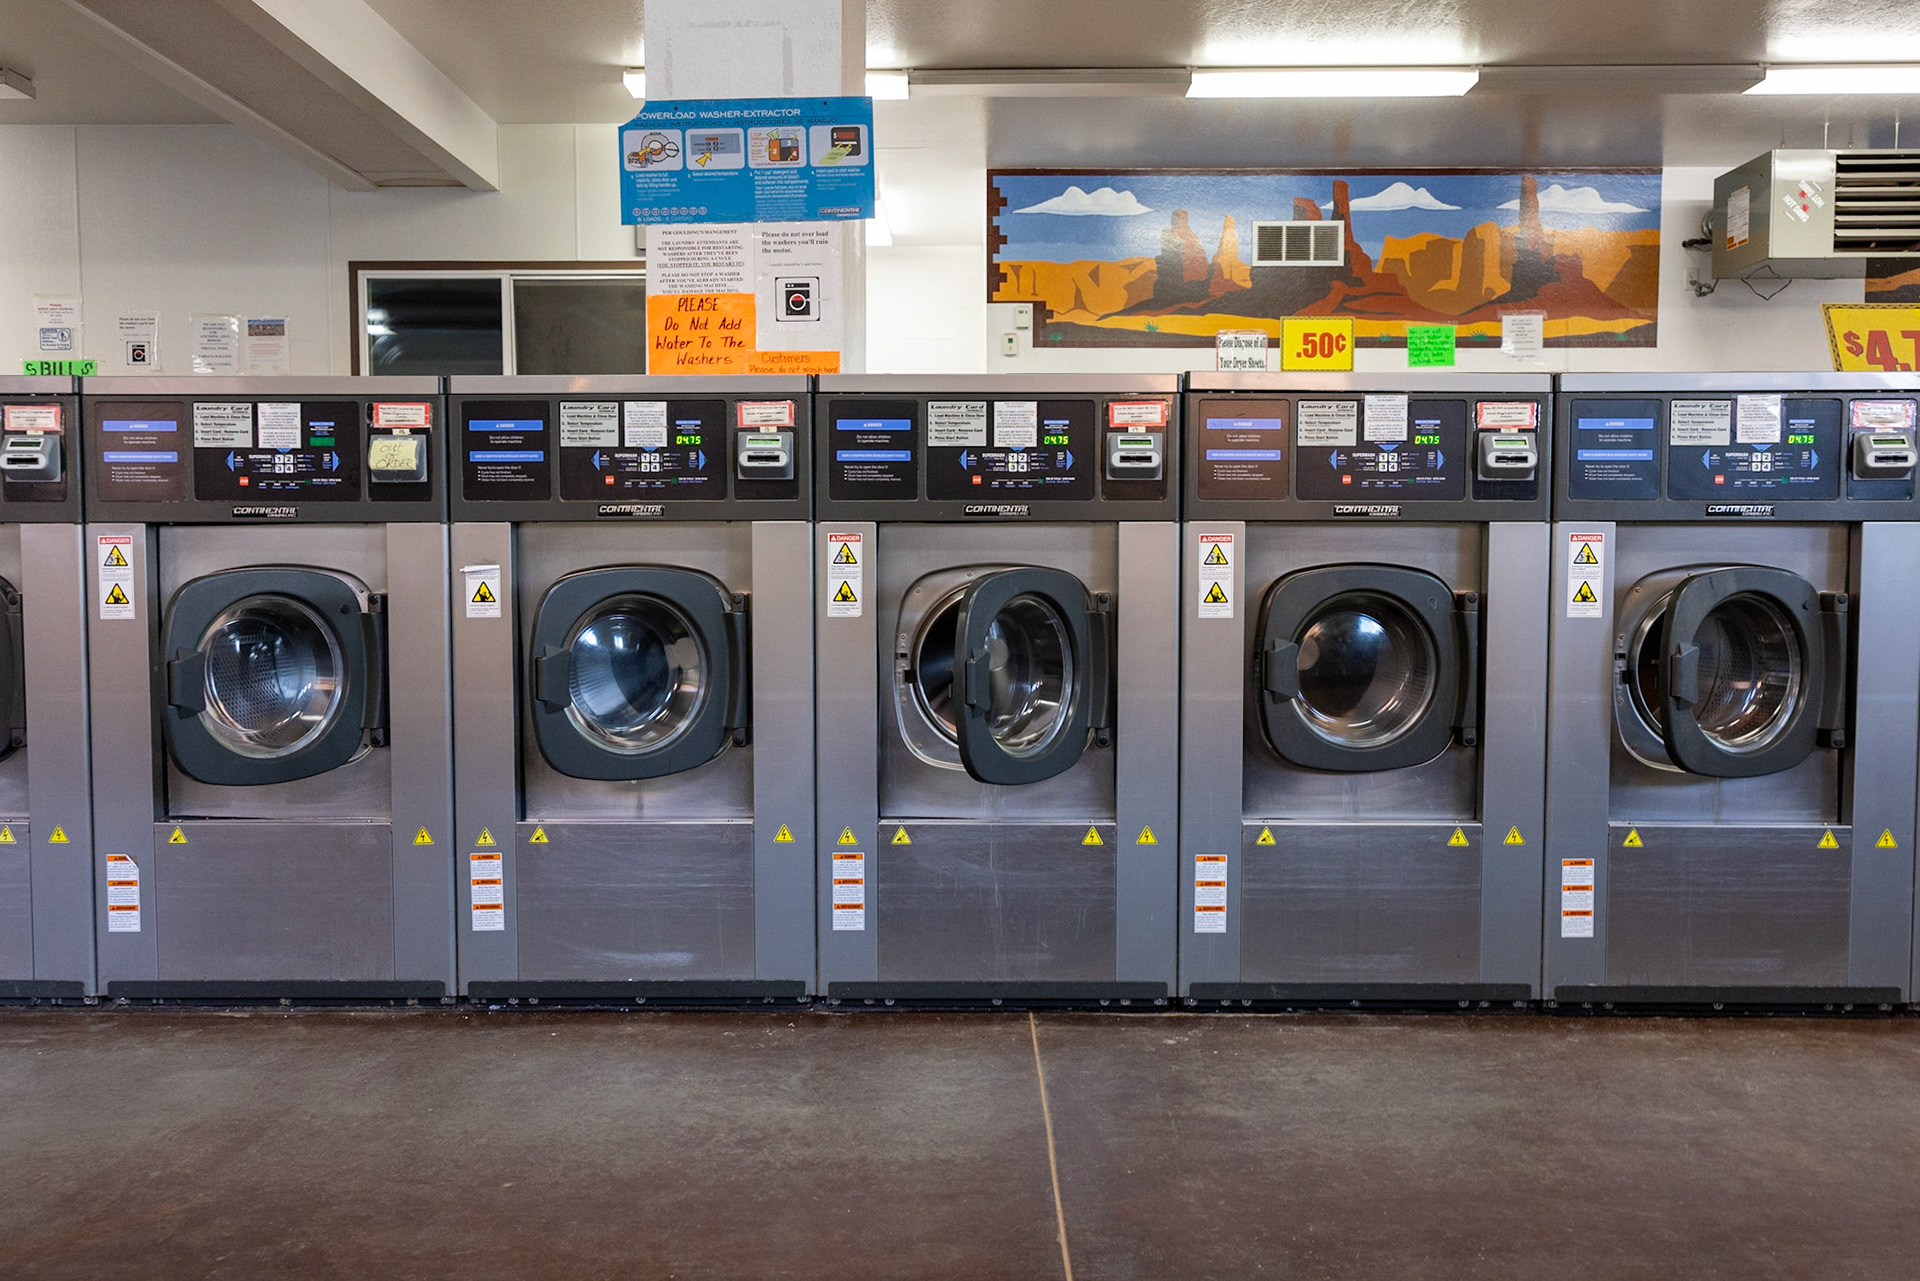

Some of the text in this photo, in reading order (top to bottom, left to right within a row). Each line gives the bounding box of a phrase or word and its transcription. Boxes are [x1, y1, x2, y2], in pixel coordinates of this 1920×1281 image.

[699, 108, 801, 118] WASHER-EXTRACTOR
[677, 297, 720, 312] PLEASE
[664, 317, 742, 331] Do Not Add
[656, 336, 746, 350] Water To The
[1219, 337, 1233, 348] Pease
[1296, 332, 1347, 358] .50¢
[677, 352, 733, 365] Washers
[761, 352, 810, 363] Customers
[749, 364, 776, 373] Please
[1220, 357, 1265, 371] Your Dryer Sheets.
[380, 442, 404, 453] OUT
[376, 458, 414, 469] ORDER
[599, 505, 663, 513] CONTINENTAL
[966, 505, 1029, 513] CONTINENTAL
[1708, 505, 1774, 513] CONTINENTAL
